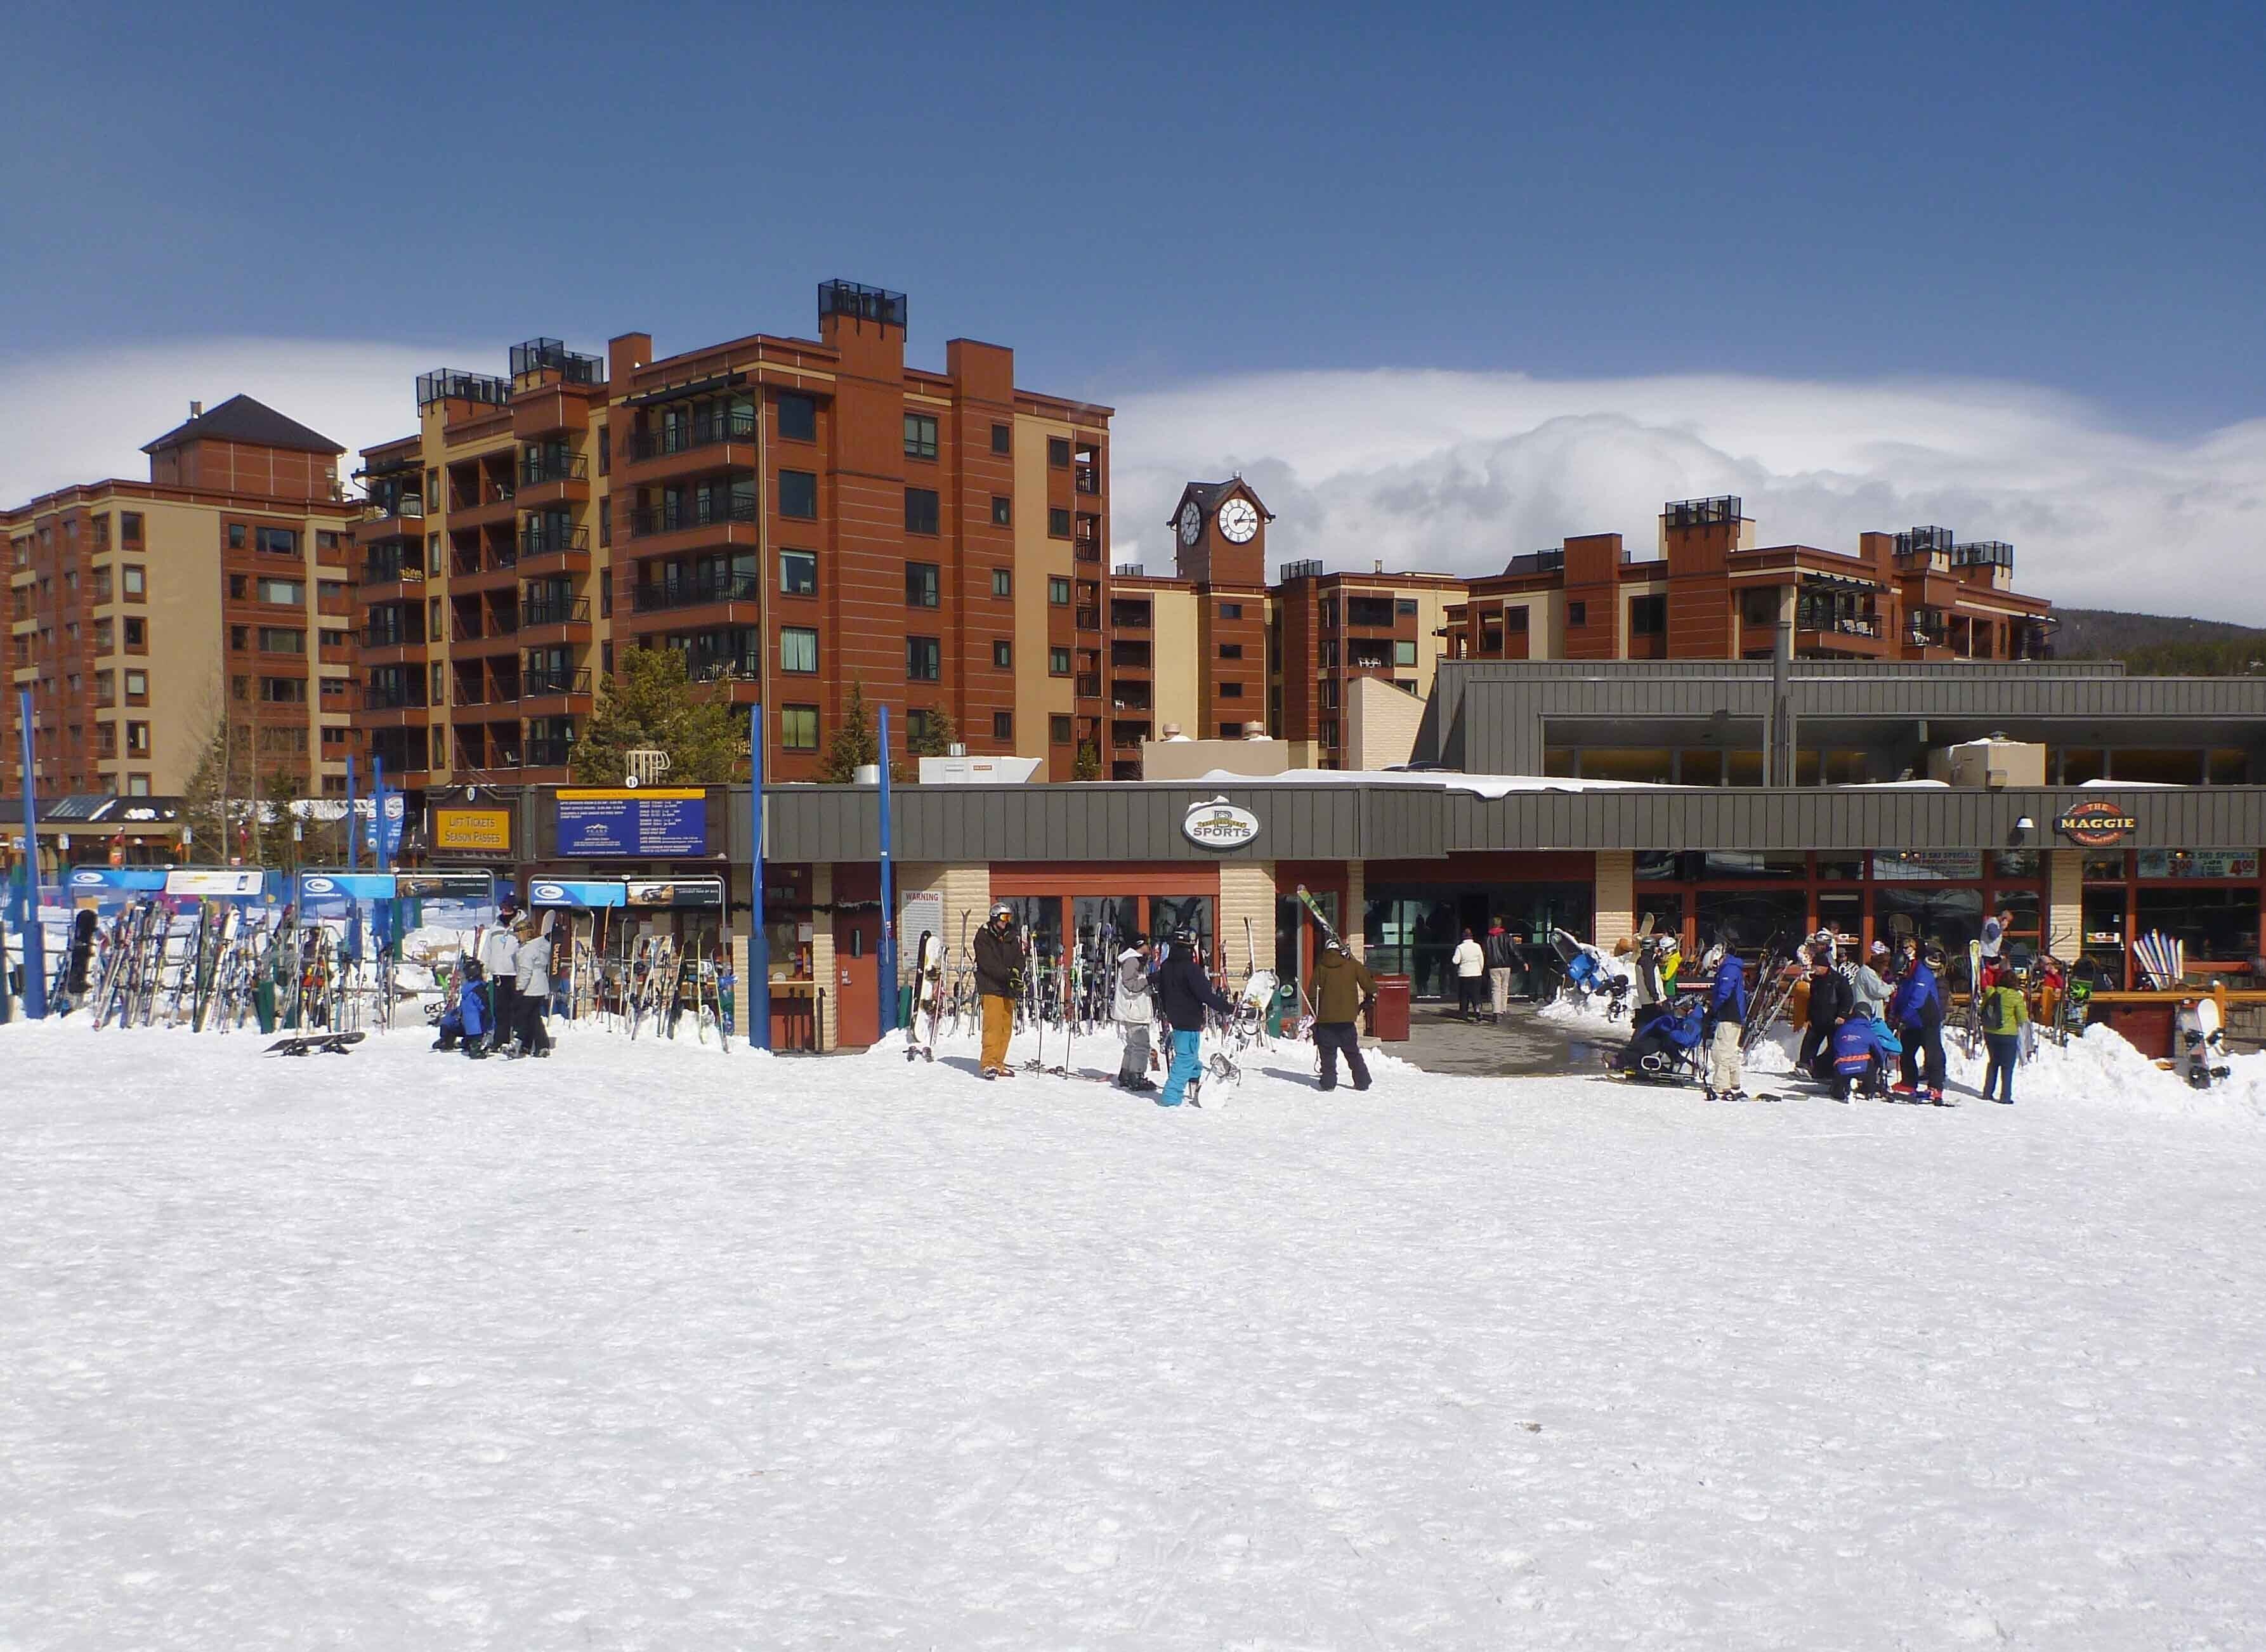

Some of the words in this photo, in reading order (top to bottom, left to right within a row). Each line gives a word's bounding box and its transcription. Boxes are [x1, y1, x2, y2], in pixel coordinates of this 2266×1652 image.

[2087, 803, 2109, 811] THE
[2060, 818, 2135, 829] MAGGIE
[1193, 827, 1251, 837] SPORTS
[906, 893, 939, 901] WARNING
[552, 943, 561, 975] burton
